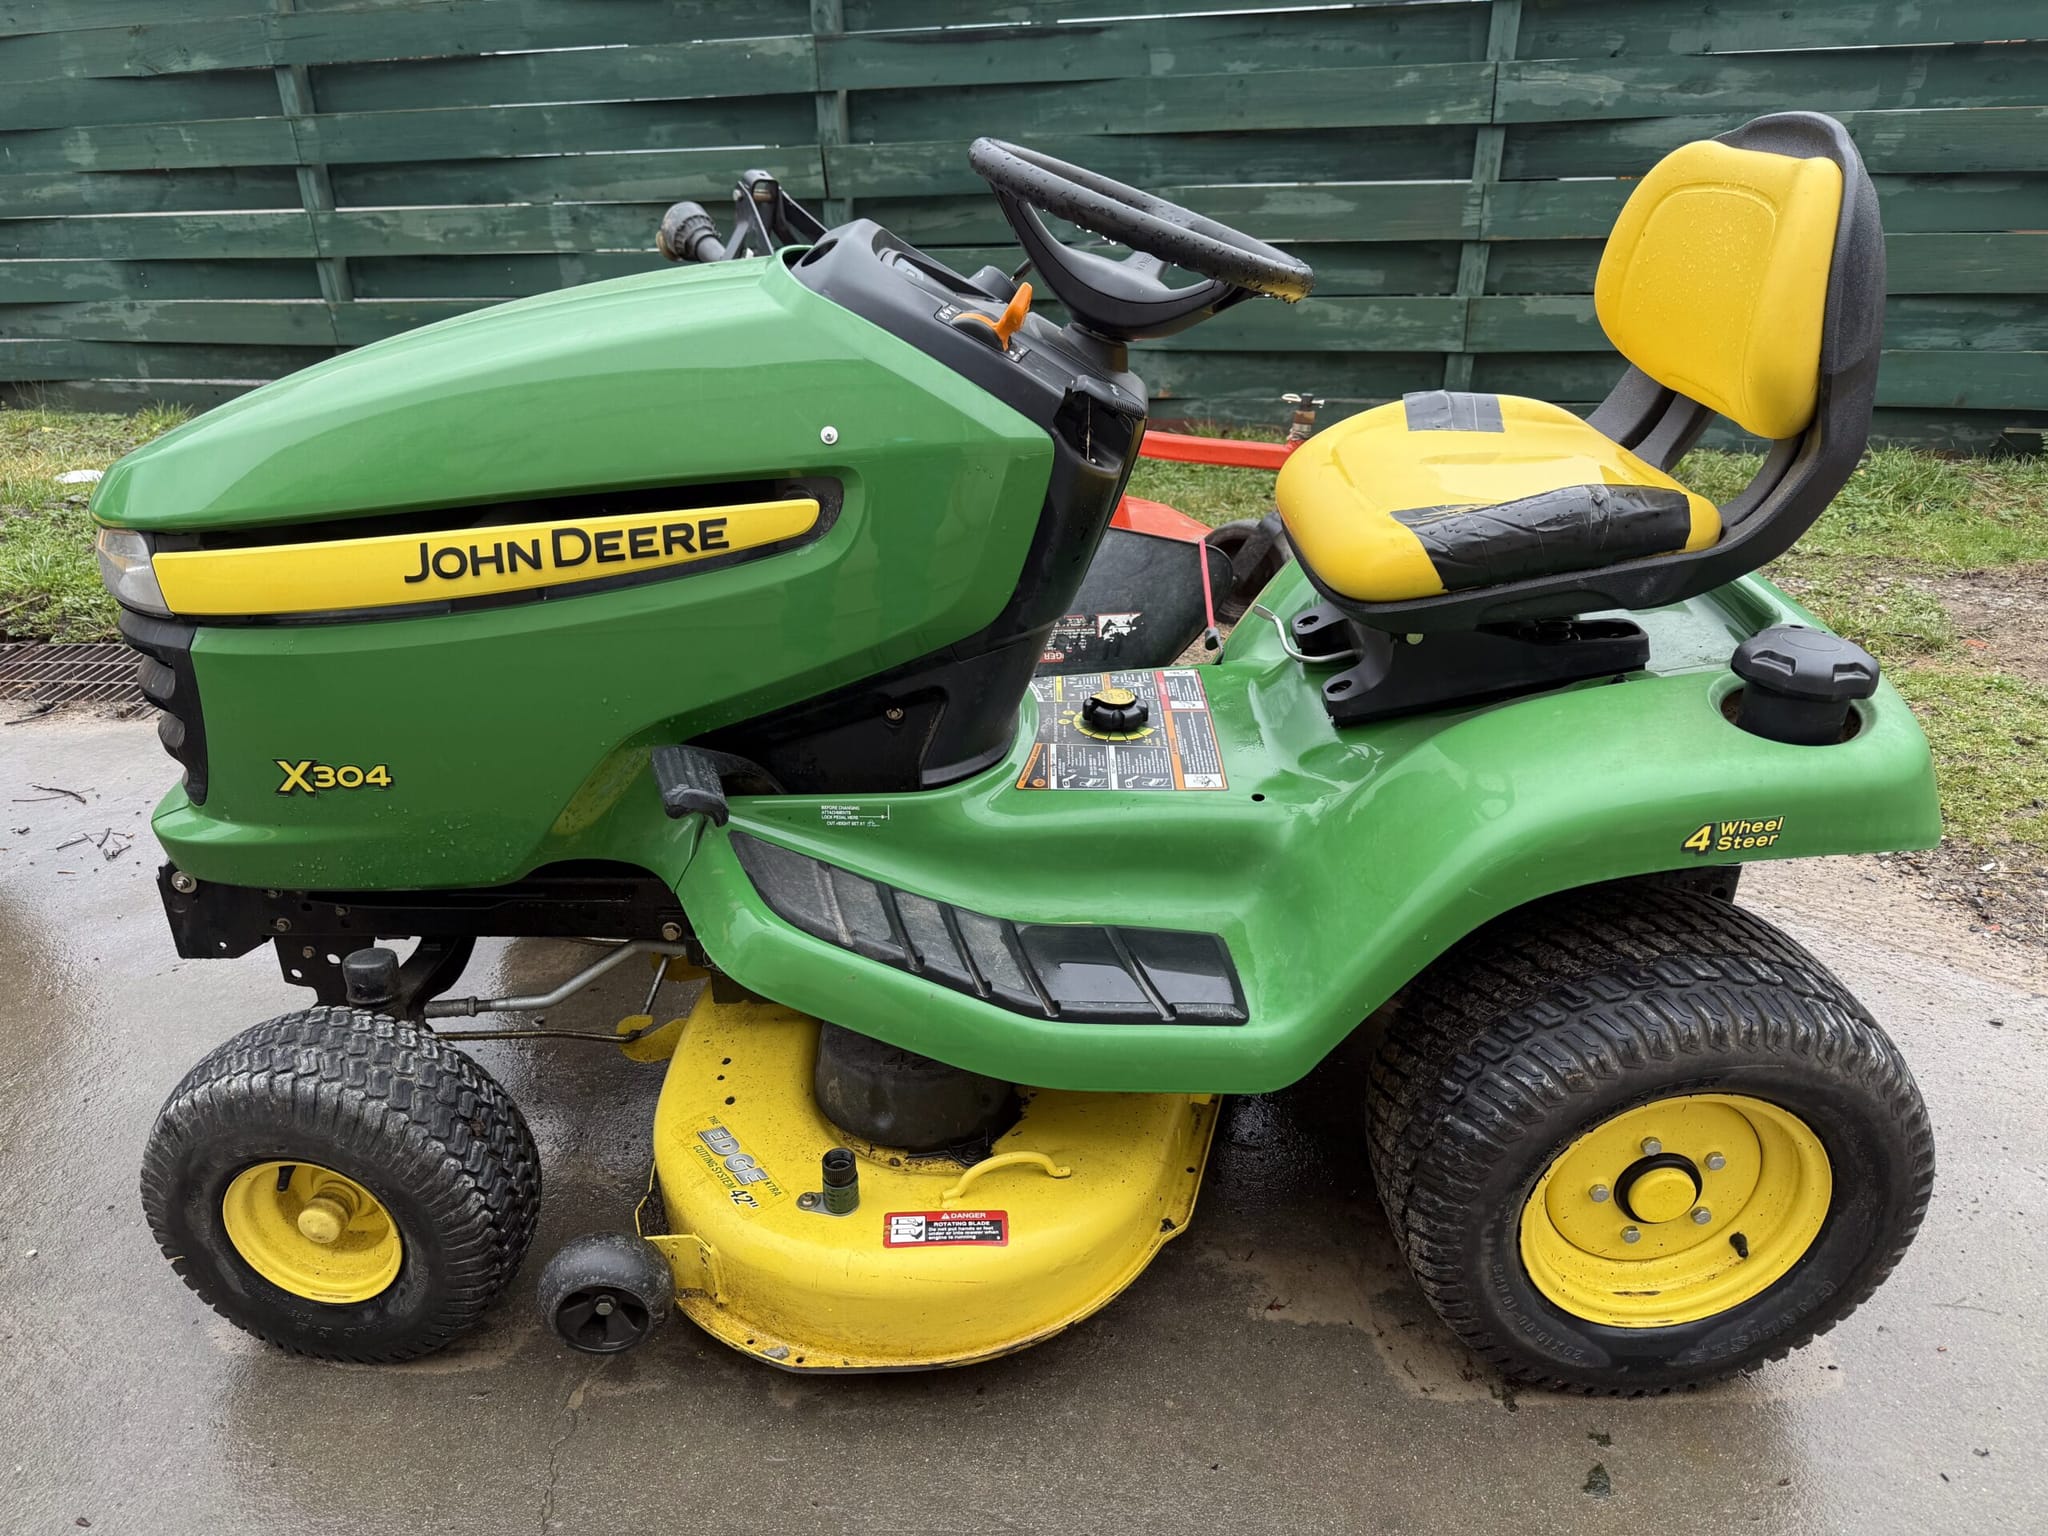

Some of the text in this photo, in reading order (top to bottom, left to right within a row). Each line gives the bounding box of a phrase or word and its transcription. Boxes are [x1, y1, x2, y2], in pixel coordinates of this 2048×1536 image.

[404, 517, 730, 584] JOHN DEERE
[272, 759, 394, 795] X304
[1682, 816, 1785, 854] 4 Wheel
[1717, 834, 1779, 852] Steer
[707, 1115, 721, 1126] THE
[696, 1126, 769, 1187] EDGE
[693, 1144, 759, 1208] CUTTING SYSTEM 42"
[763, 1180, 783, 1197] XTRA
